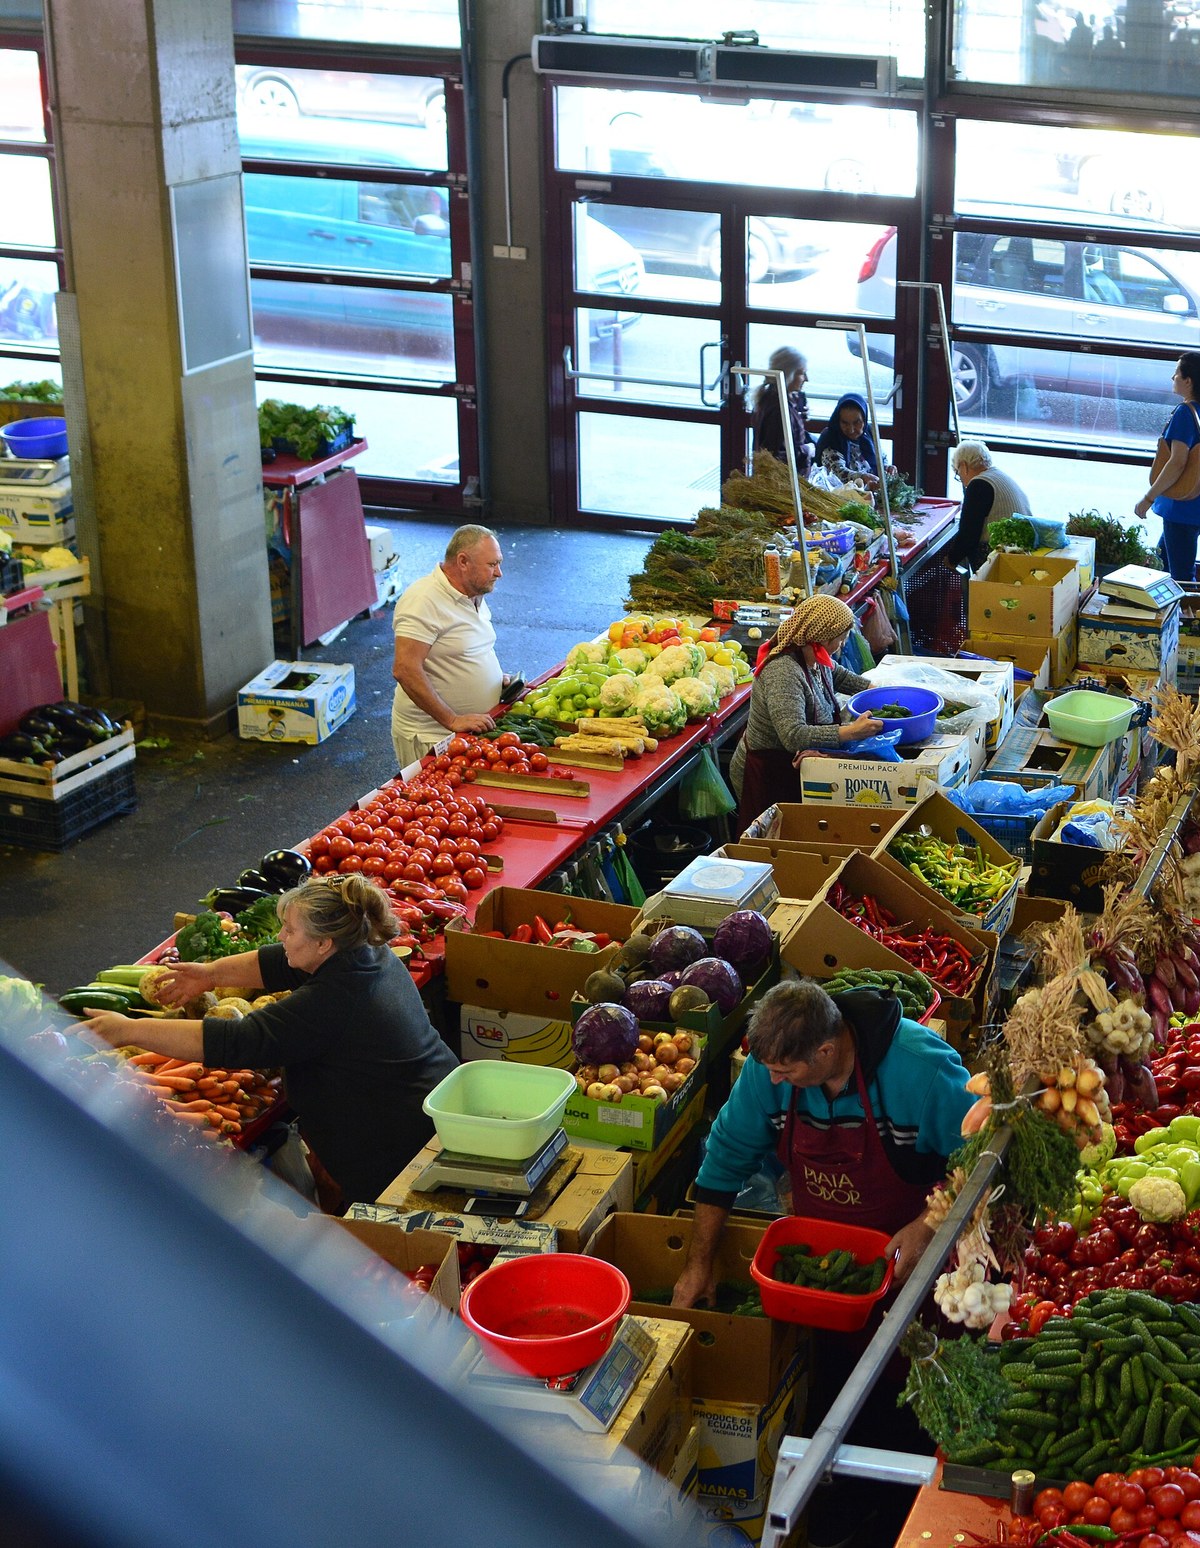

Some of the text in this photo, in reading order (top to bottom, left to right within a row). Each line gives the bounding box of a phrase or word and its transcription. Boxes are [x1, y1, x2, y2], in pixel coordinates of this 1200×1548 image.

[244, 698, 309, 708] PREMIUM BANANAS
[838, 763, 898, 773] PREMIUM PACK
[844, 778, 892, 801] BONITA
[476, 1025, 503, 1038] Dole
[564, 1108, 589, 1120] uca
[693, 1409, 751, 1426] PRODUCE OF
[707, 1420, 753, 1433] ECUADOR
[712, 1428, 736, 1437] VACUUM
[695, 1483, 747, 1498] NANAS
